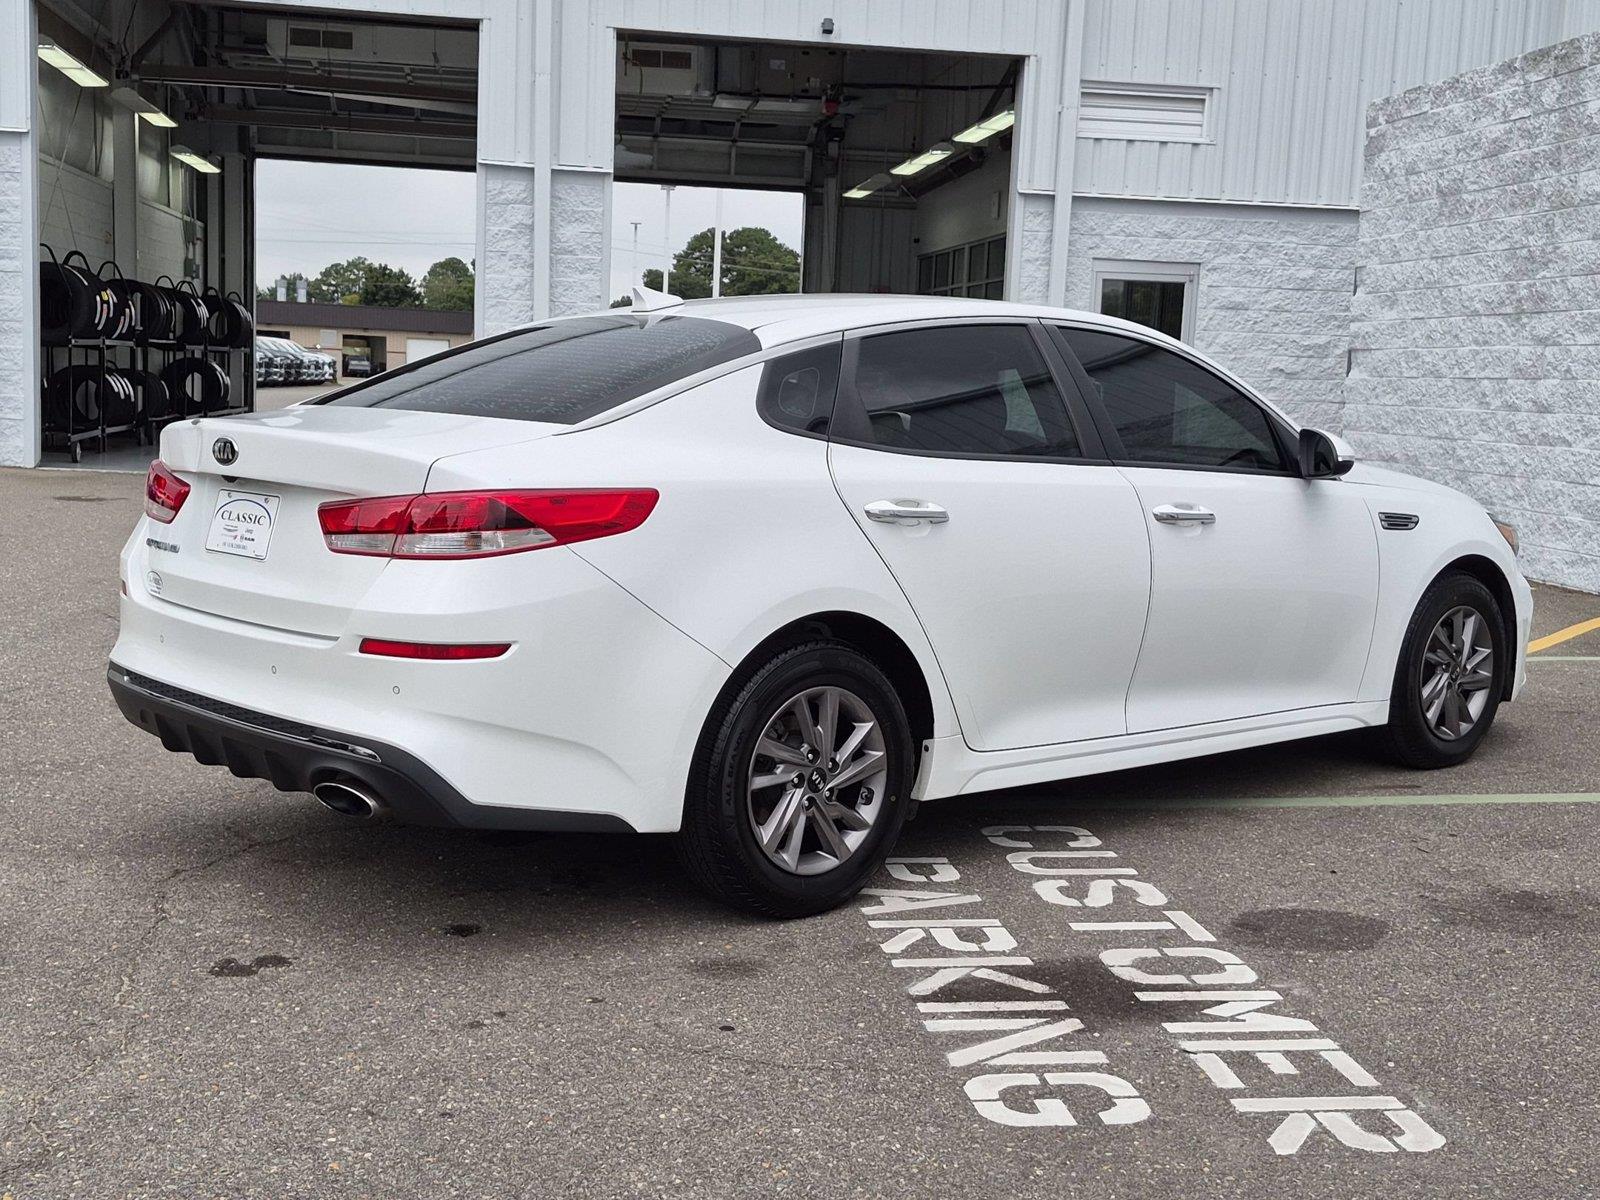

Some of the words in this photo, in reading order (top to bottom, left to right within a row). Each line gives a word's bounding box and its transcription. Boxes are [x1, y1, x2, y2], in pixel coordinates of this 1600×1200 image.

[214, 442, 233, 460] KIA
[220, 509, 267, 527] CLASSIC
[811, 770, 825, 790] KIA
[858, 856, 1151, 1127] PARKING
[981, 825, 1447, 1156] CUSTOMER
